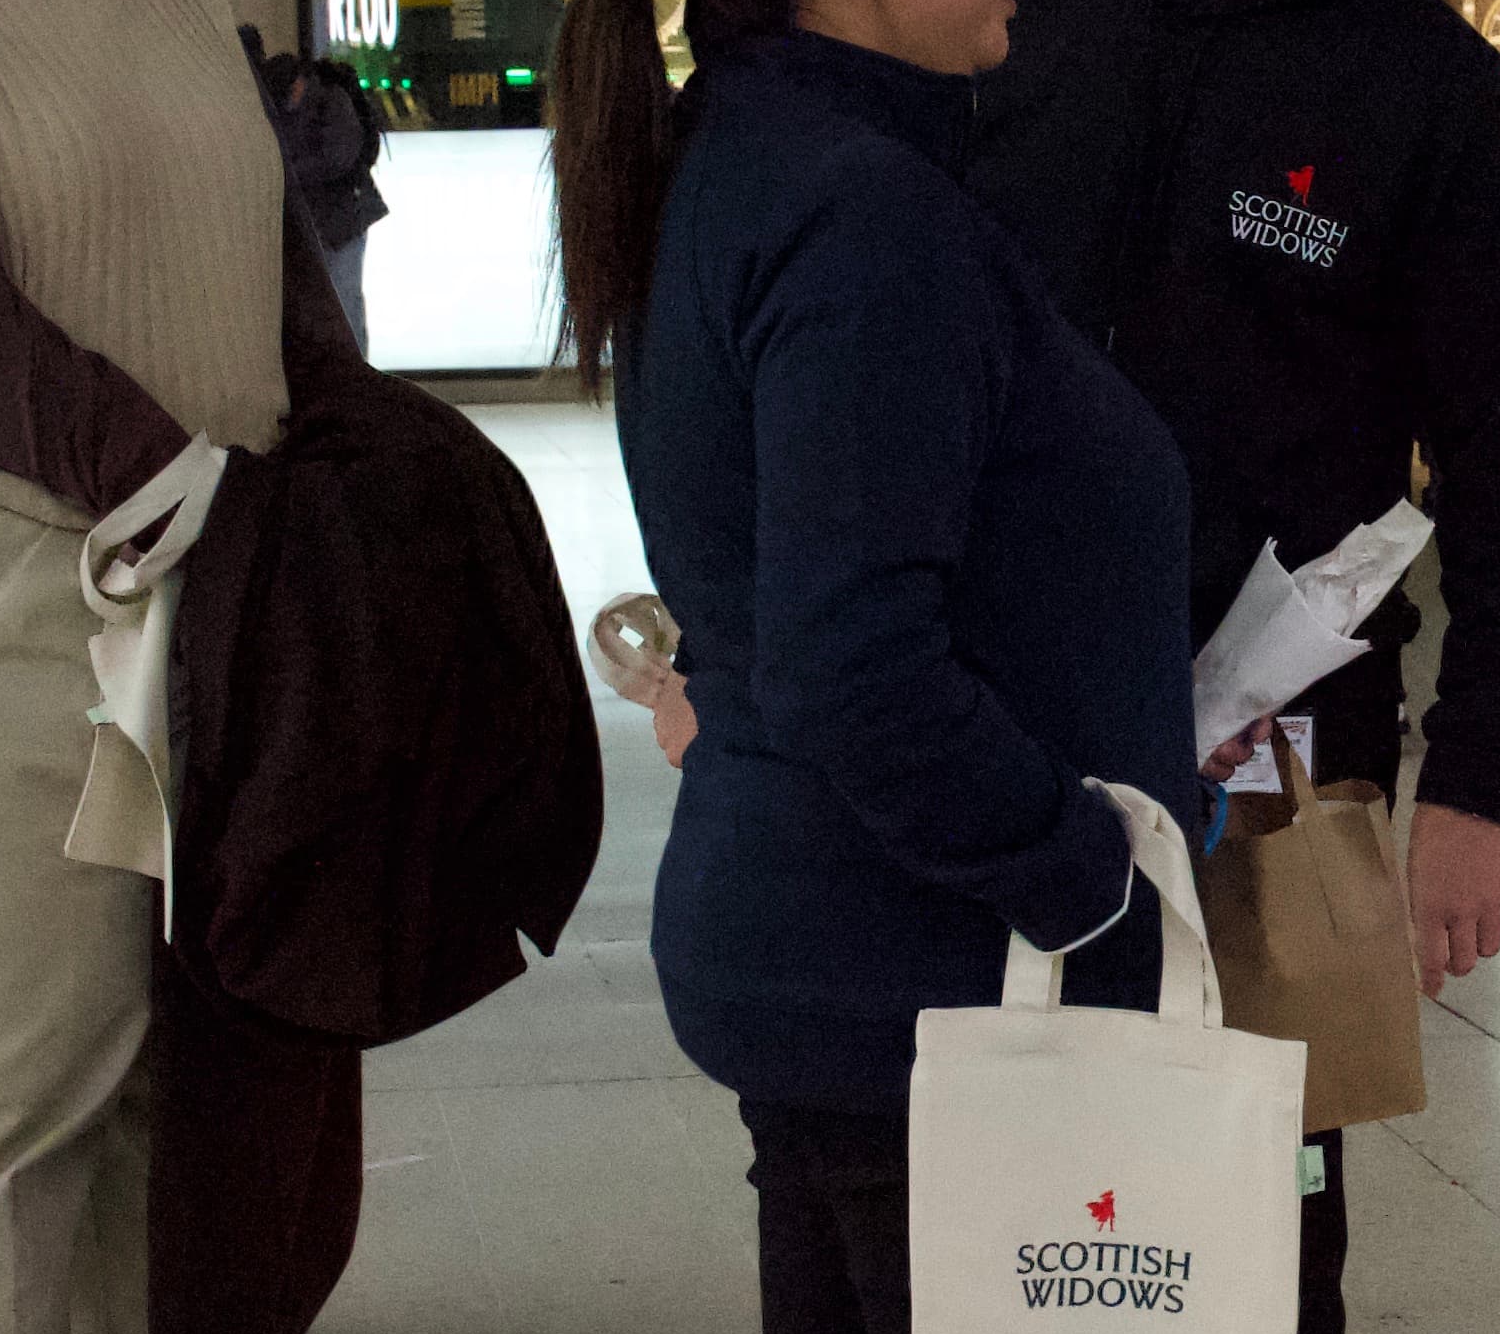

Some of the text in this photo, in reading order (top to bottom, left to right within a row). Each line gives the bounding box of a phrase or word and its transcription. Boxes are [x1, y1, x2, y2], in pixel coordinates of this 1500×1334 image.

[1229, 190, 1349, 248] SCOTTISH
[1231, 214, 1338, 268] WIDOWS
[1016, 1241, 1193, 1282] SCOTTISH
[1022, 1277, 1185, 1315] WIDOWS
